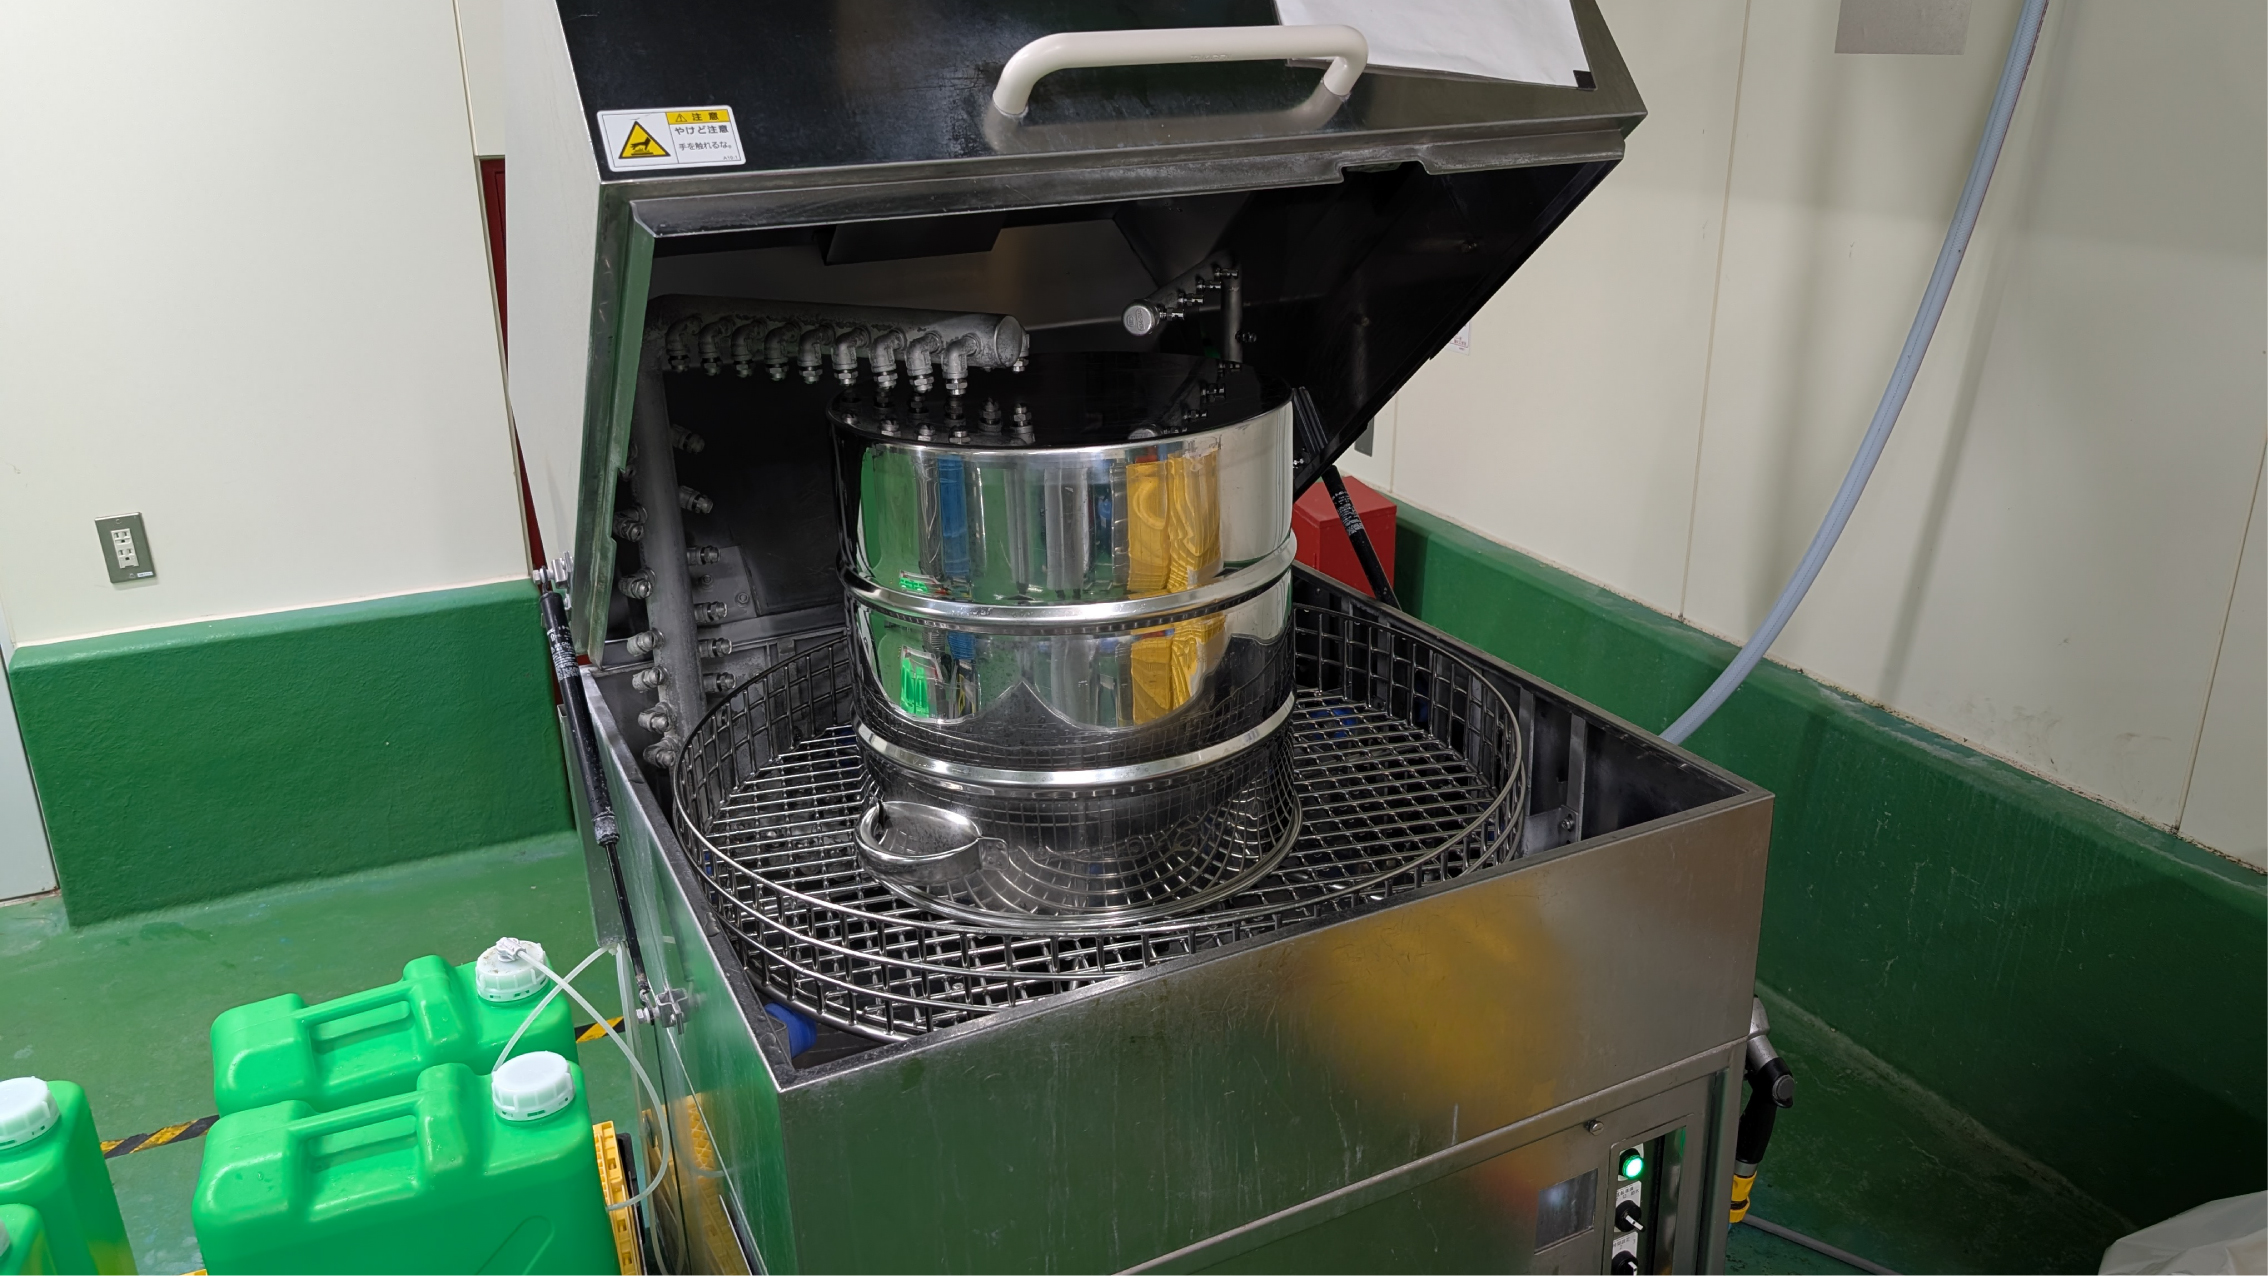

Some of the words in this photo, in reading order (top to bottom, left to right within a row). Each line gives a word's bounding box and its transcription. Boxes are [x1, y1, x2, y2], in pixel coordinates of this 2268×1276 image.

[692, 112, 719, 121] 注意
[675, 125, 729, 135] やけど注意
[679, 142, 732, 151] 手を触れるな。
